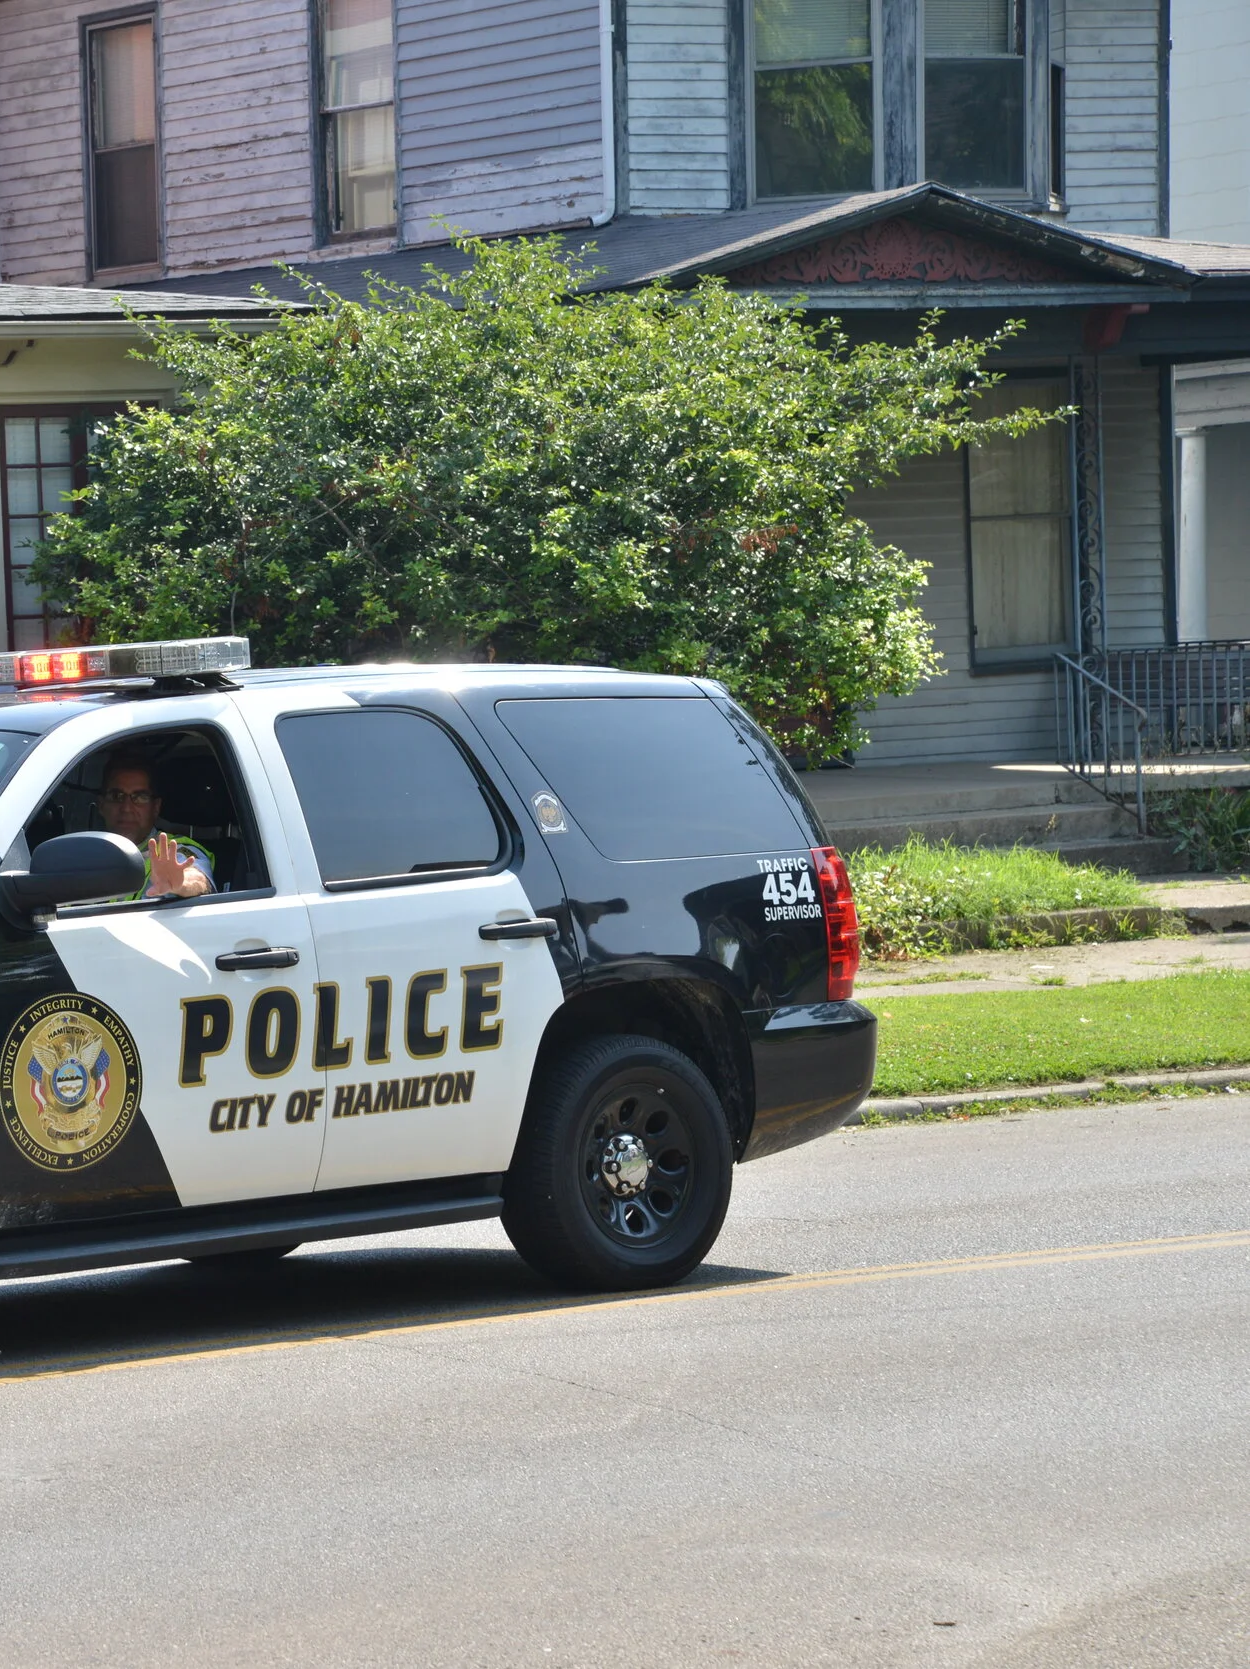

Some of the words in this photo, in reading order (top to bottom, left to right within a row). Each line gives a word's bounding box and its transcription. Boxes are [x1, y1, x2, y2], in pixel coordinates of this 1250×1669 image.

[757, 857, 808, 873] TRAFFIC
[762, 872, 816, 905] 454
[764, 904, 822, 922] SUPERVISOR
[29, 999, 83, 1023] INTEGRITY
[178, 961, 503, 1089] POLICE
[47, 1026, 86, 1041] HAMILTON
[103, 1015, 134, 1067] EMPATHY
[2, 1038, 19, 1089] JUSTICE
[209, 1094, 276, 1133] CITY
[285, 1088, 325, 1124] OF
[331, 1070, 475, 1119] HAMILTON
[9, 1116, 59, 1166] EXCELLENCE
[54, 1127, 91, 1141] POLICE
[82, 1092, 135, 1163] COOPERATION
